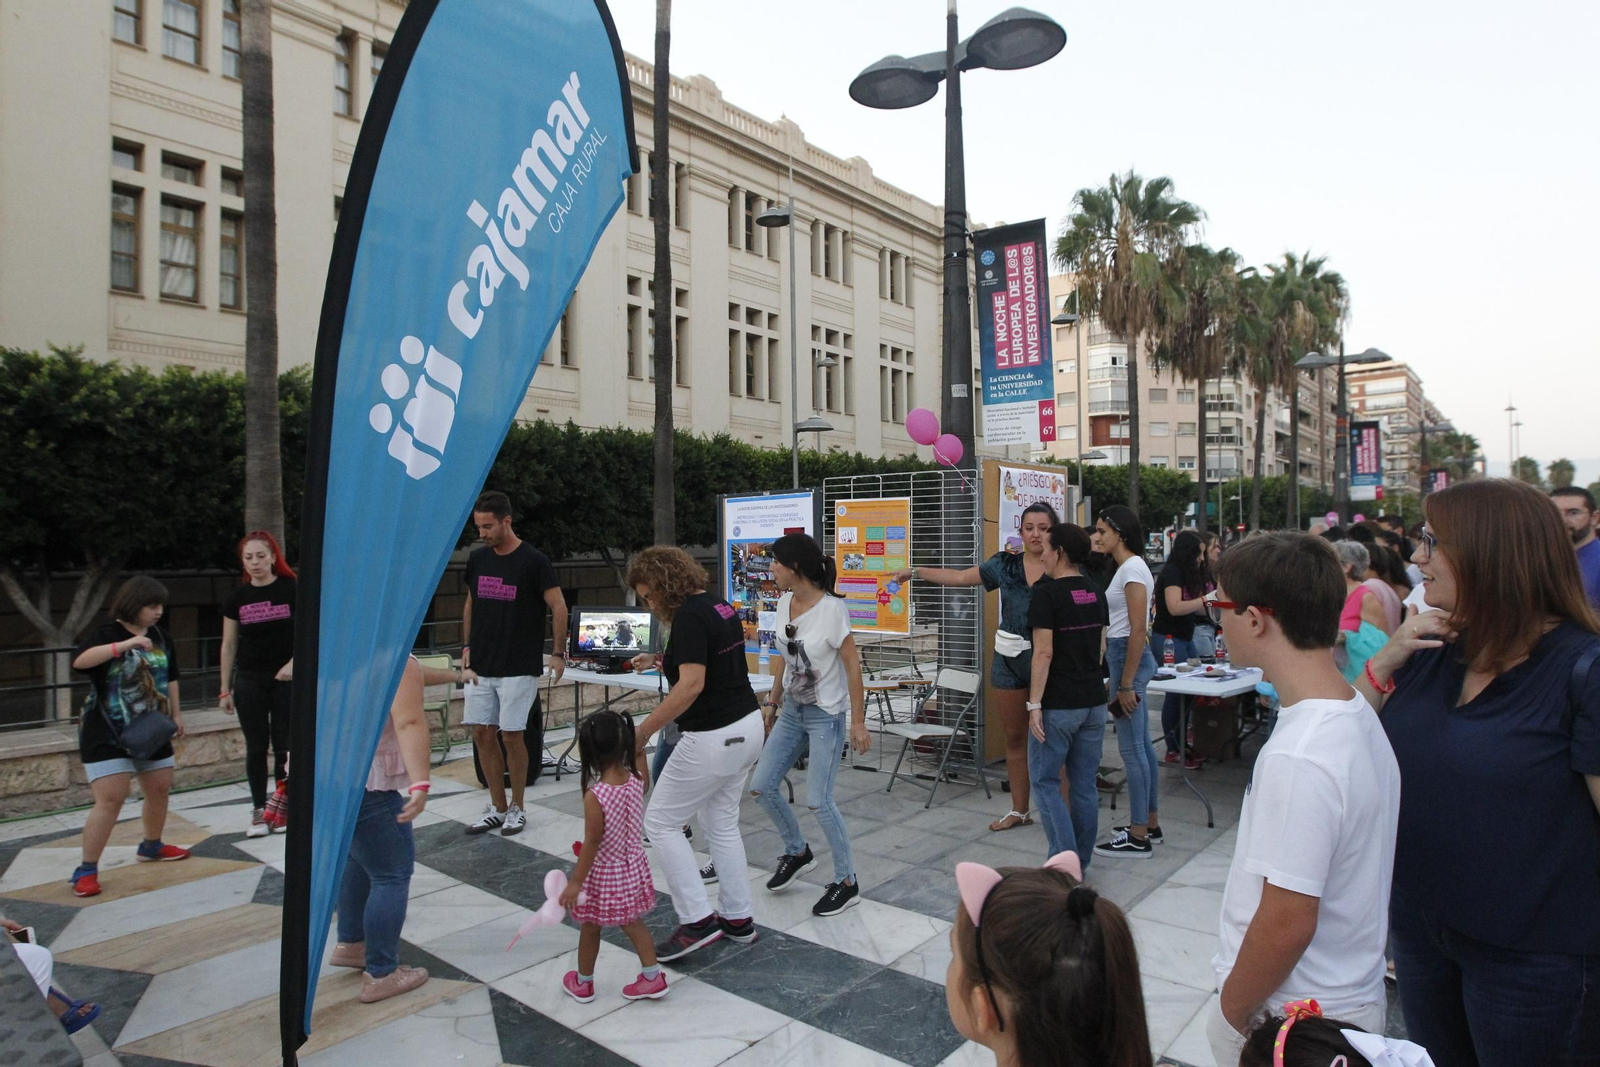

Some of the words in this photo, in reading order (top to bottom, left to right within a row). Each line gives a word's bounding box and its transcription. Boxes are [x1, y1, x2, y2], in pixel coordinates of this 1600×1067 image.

[548, 181, 578, 234] CAJA
[571, 127, 608, 186] RURAL
[447, 71, 591, 340] cajamar
[1007, 248, 1019, 278] L@S
[1009, 279, 1020, 298] DE
[1022, 246, 1039, 363] INVESTIGADOR@S
[994, 294, 1008, 342] NOCHE
[1010, 302, 1024, 365] EUROPEA
[998, 348, 1009, 366] LA
[998, 380, 1043, 390] UNIVERSIDAD
[1042, 406, 1053, 416] 66
[1043, 426, 1053, 435] 67
[1018, 473, 1050, 488] ¿RIESGO
[1017, 494, 1028, 507] DE
